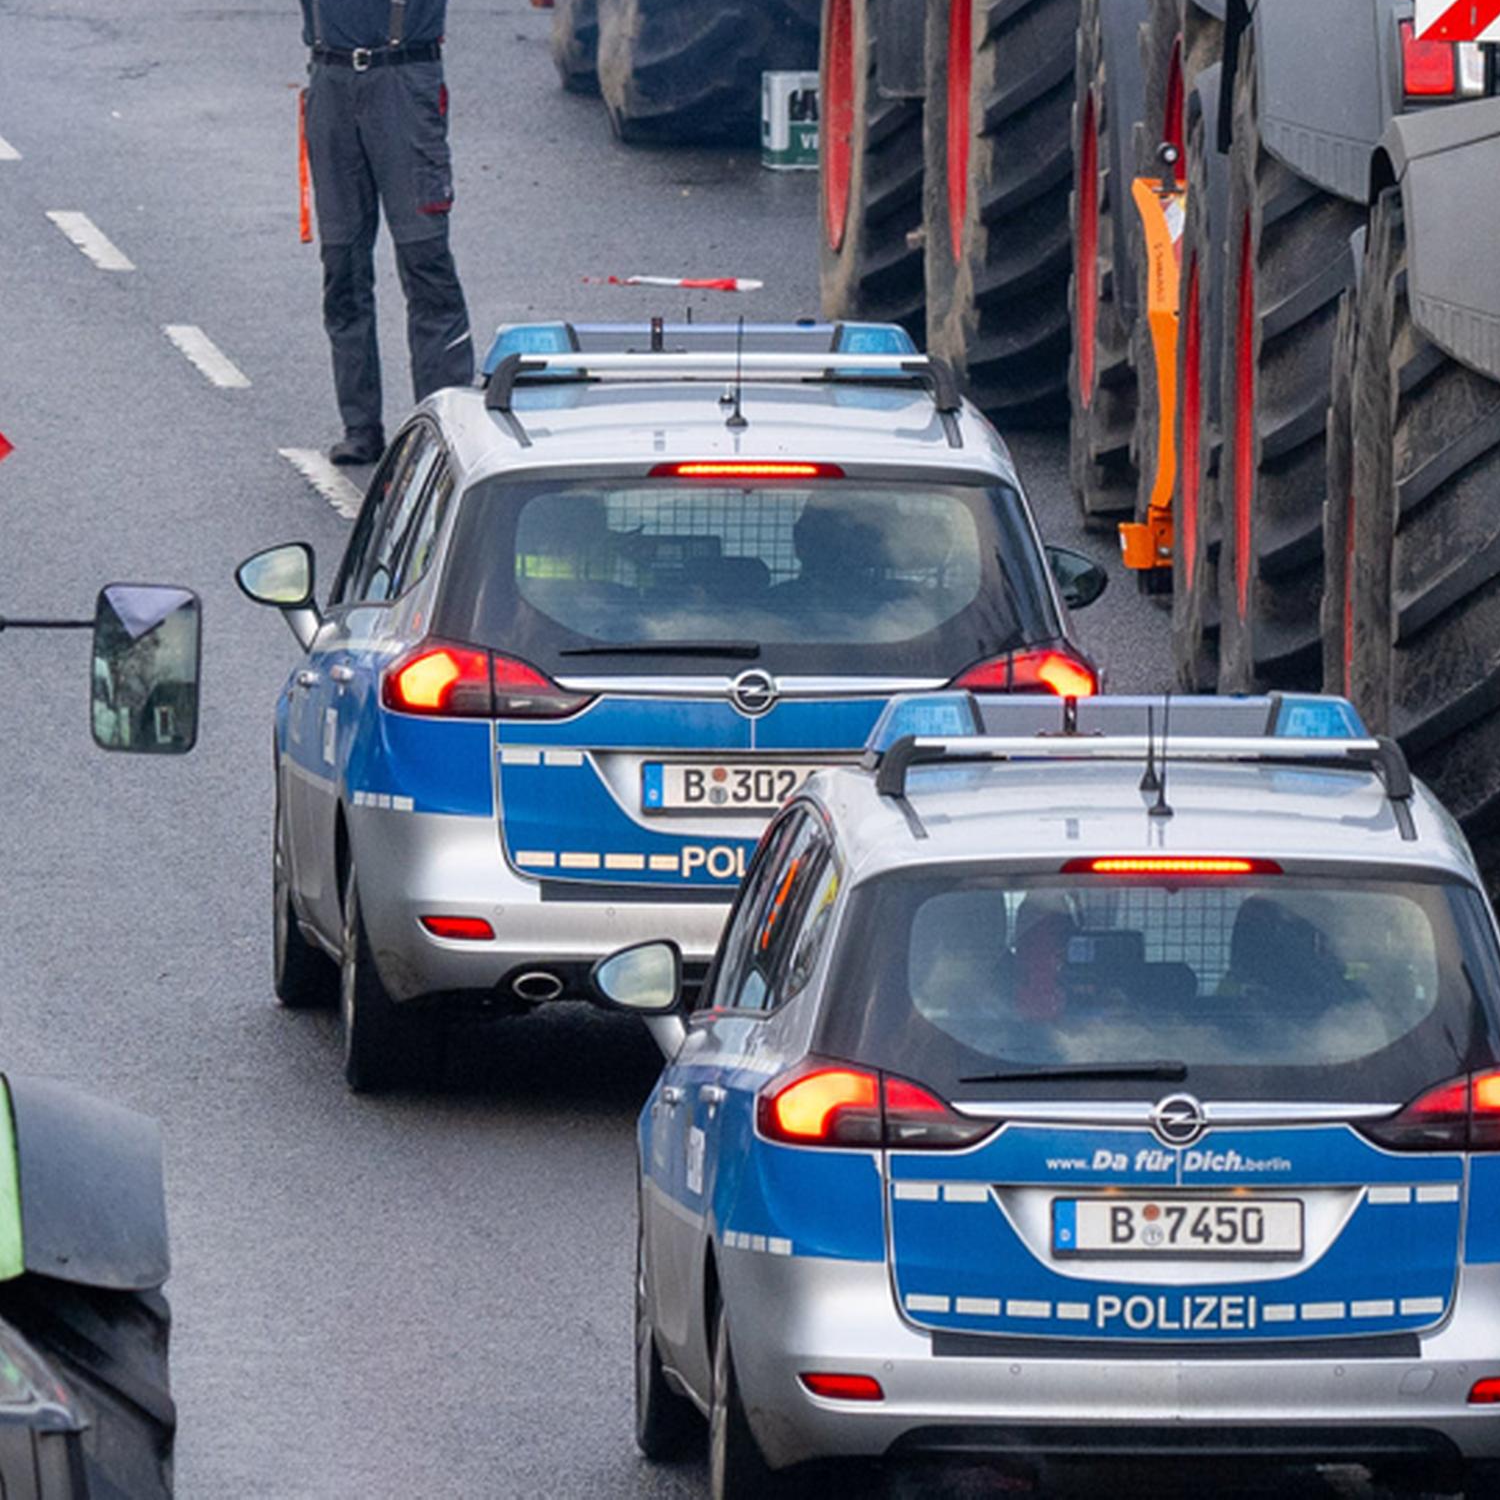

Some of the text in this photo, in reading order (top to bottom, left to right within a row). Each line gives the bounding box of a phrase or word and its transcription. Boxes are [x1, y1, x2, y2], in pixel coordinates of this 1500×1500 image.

[684, 769, 705, 803] B
[732, 769, 817, 803] 302
[681, 846, 748, 879] POL
[1133, 1149, 1175, 1172] für
[1110, 1206, 1135, 1244] B
[1164, 1206, 1265, 1244] 7450
[1096, 1295, 1256, 1330] POLIZEI
